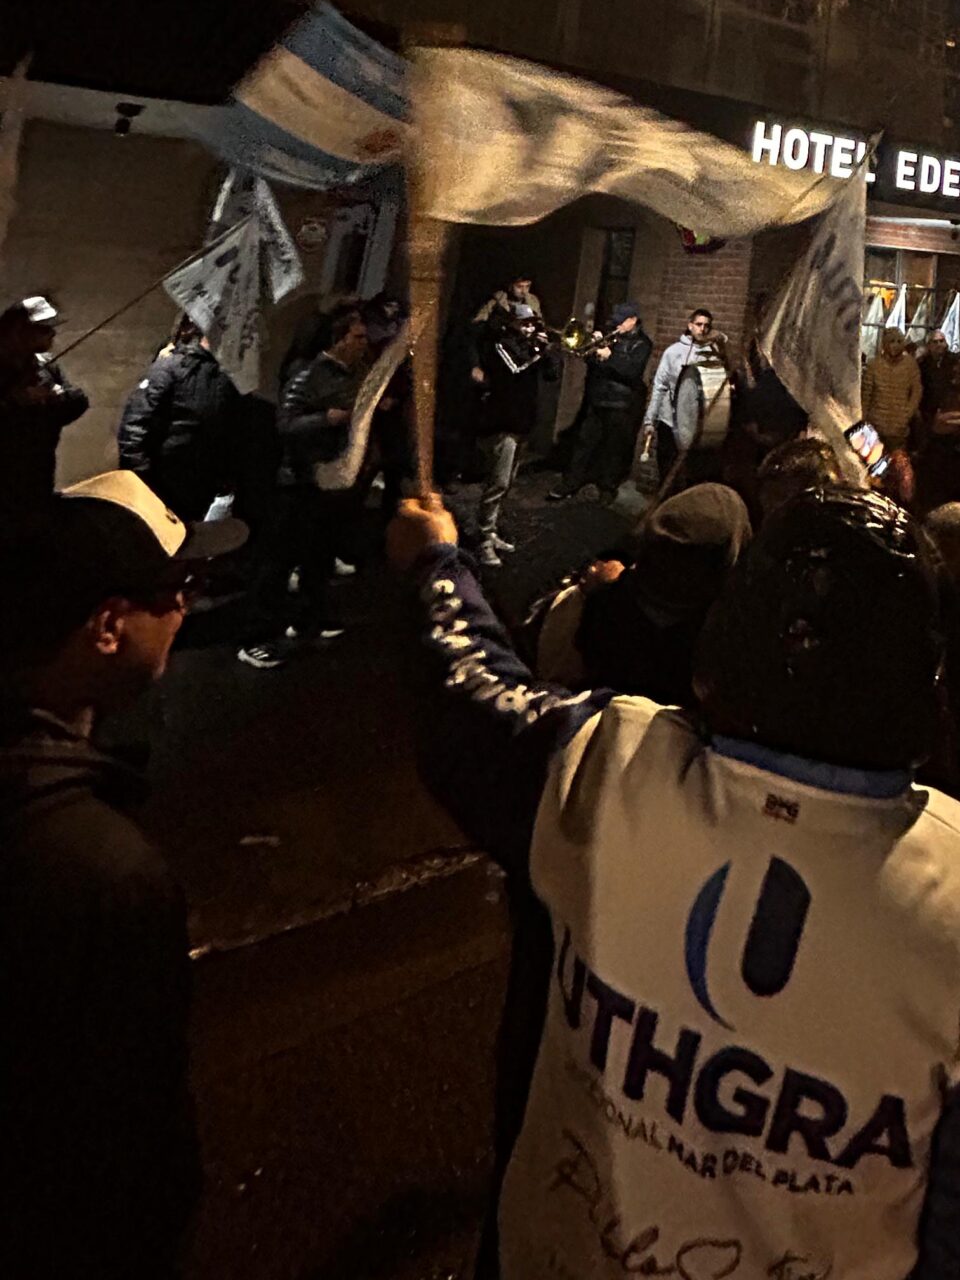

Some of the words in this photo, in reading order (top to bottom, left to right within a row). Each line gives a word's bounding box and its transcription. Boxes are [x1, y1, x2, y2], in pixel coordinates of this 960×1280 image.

[752, 121, 876, 183] HOTEL
[556, 924, 913, 1170] UTHGRA
[666, 1134, 717, 1179] MAR
[721, 1147, 766, 1181] DEL
[771, 1169, 854, 1196] PLATA
